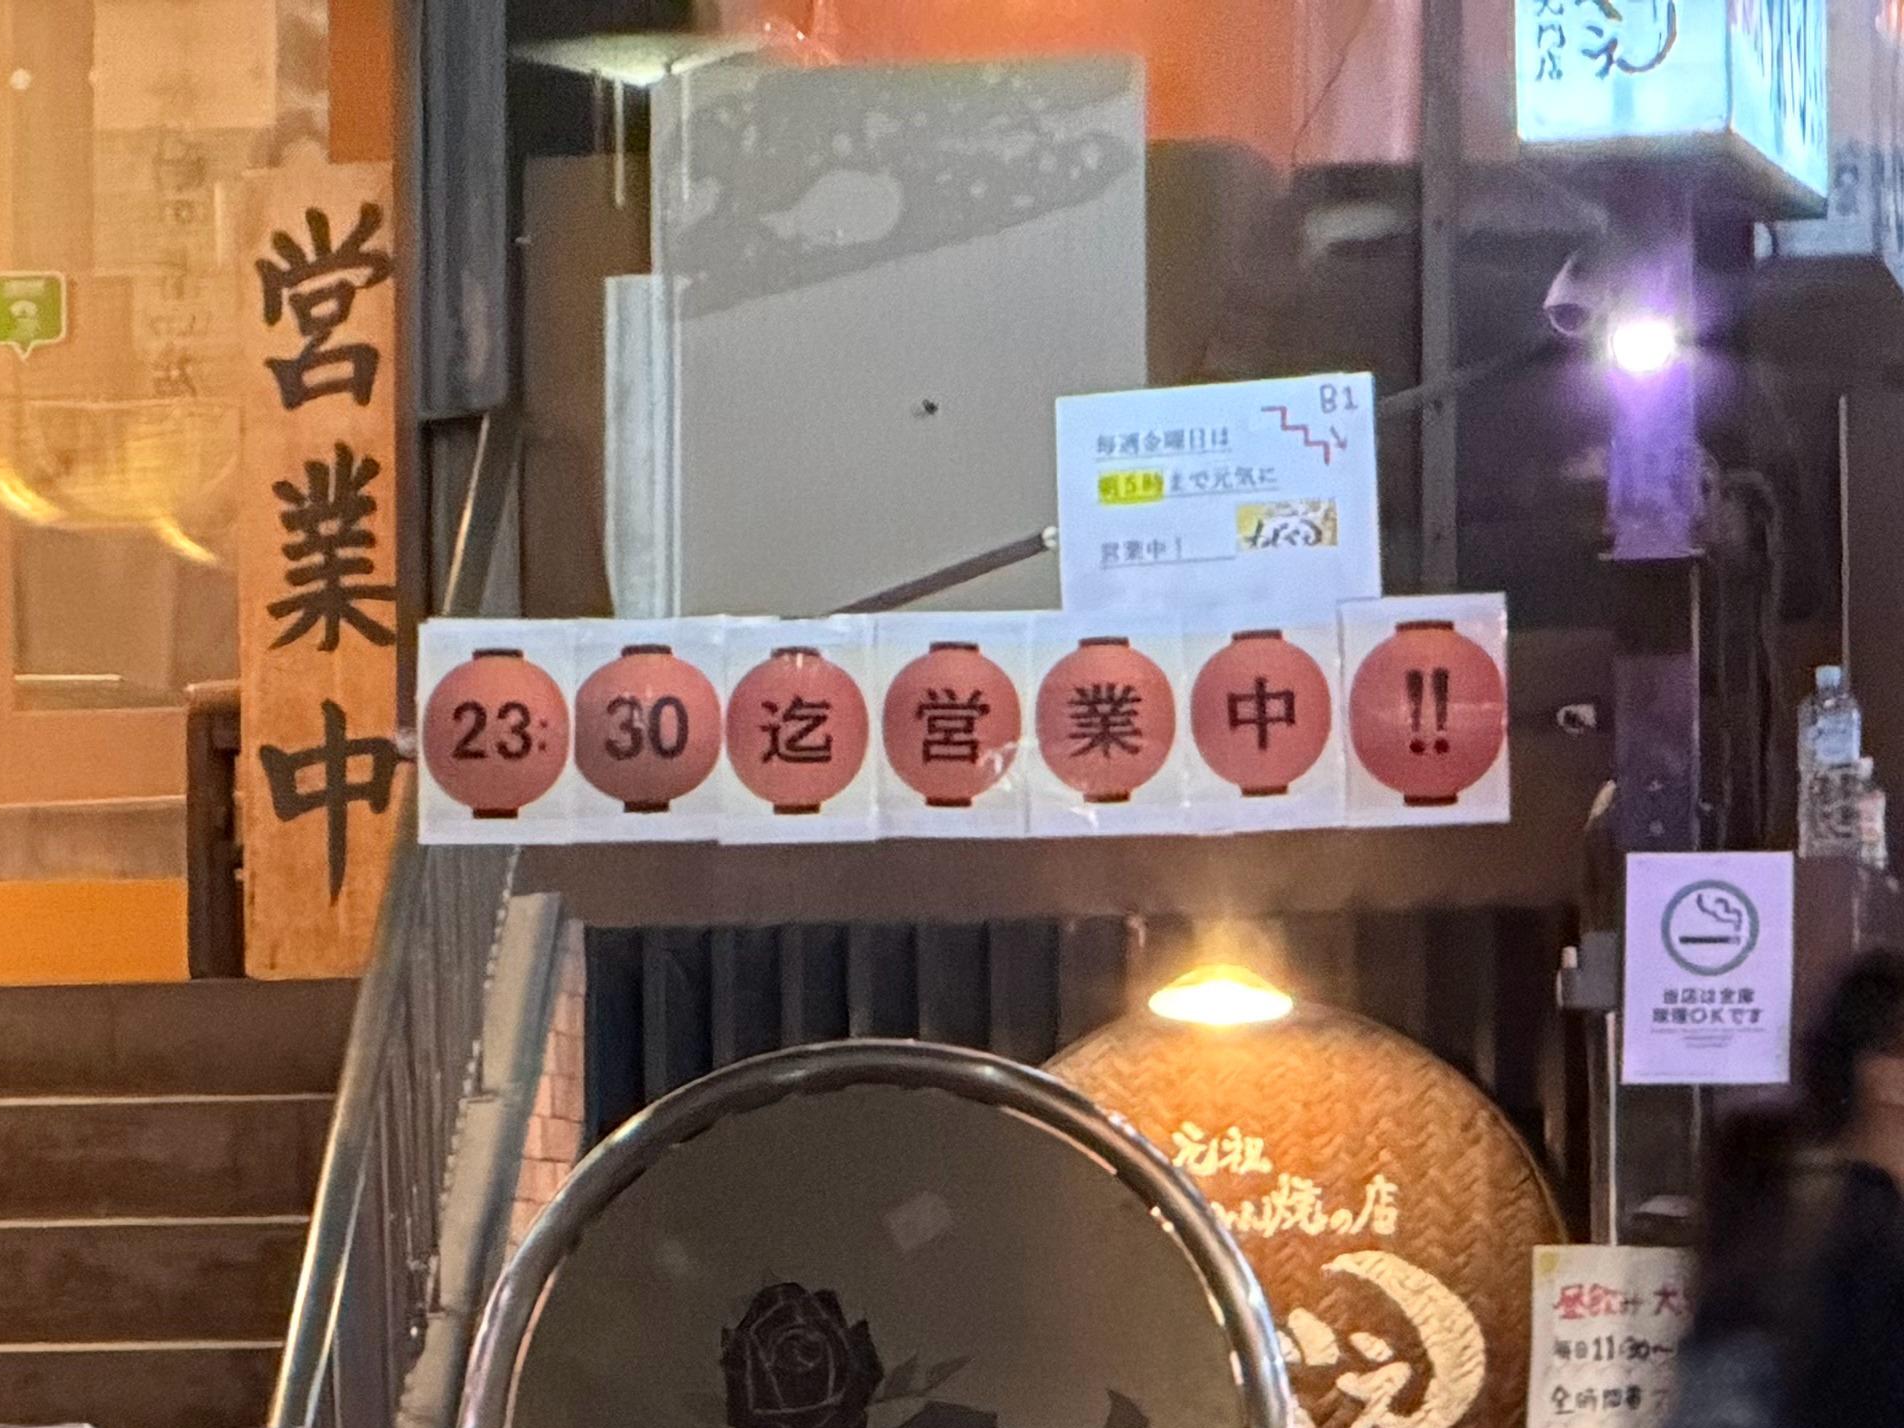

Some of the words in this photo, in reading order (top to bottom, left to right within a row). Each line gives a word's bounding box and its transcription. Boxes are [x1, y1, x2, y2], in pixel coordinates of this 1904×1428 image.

[1319, 383, 1359, 414] B1
[1097, 426, 1229, 455] 毎週金曜日は
[254, 201, 398, 908] 営業中
